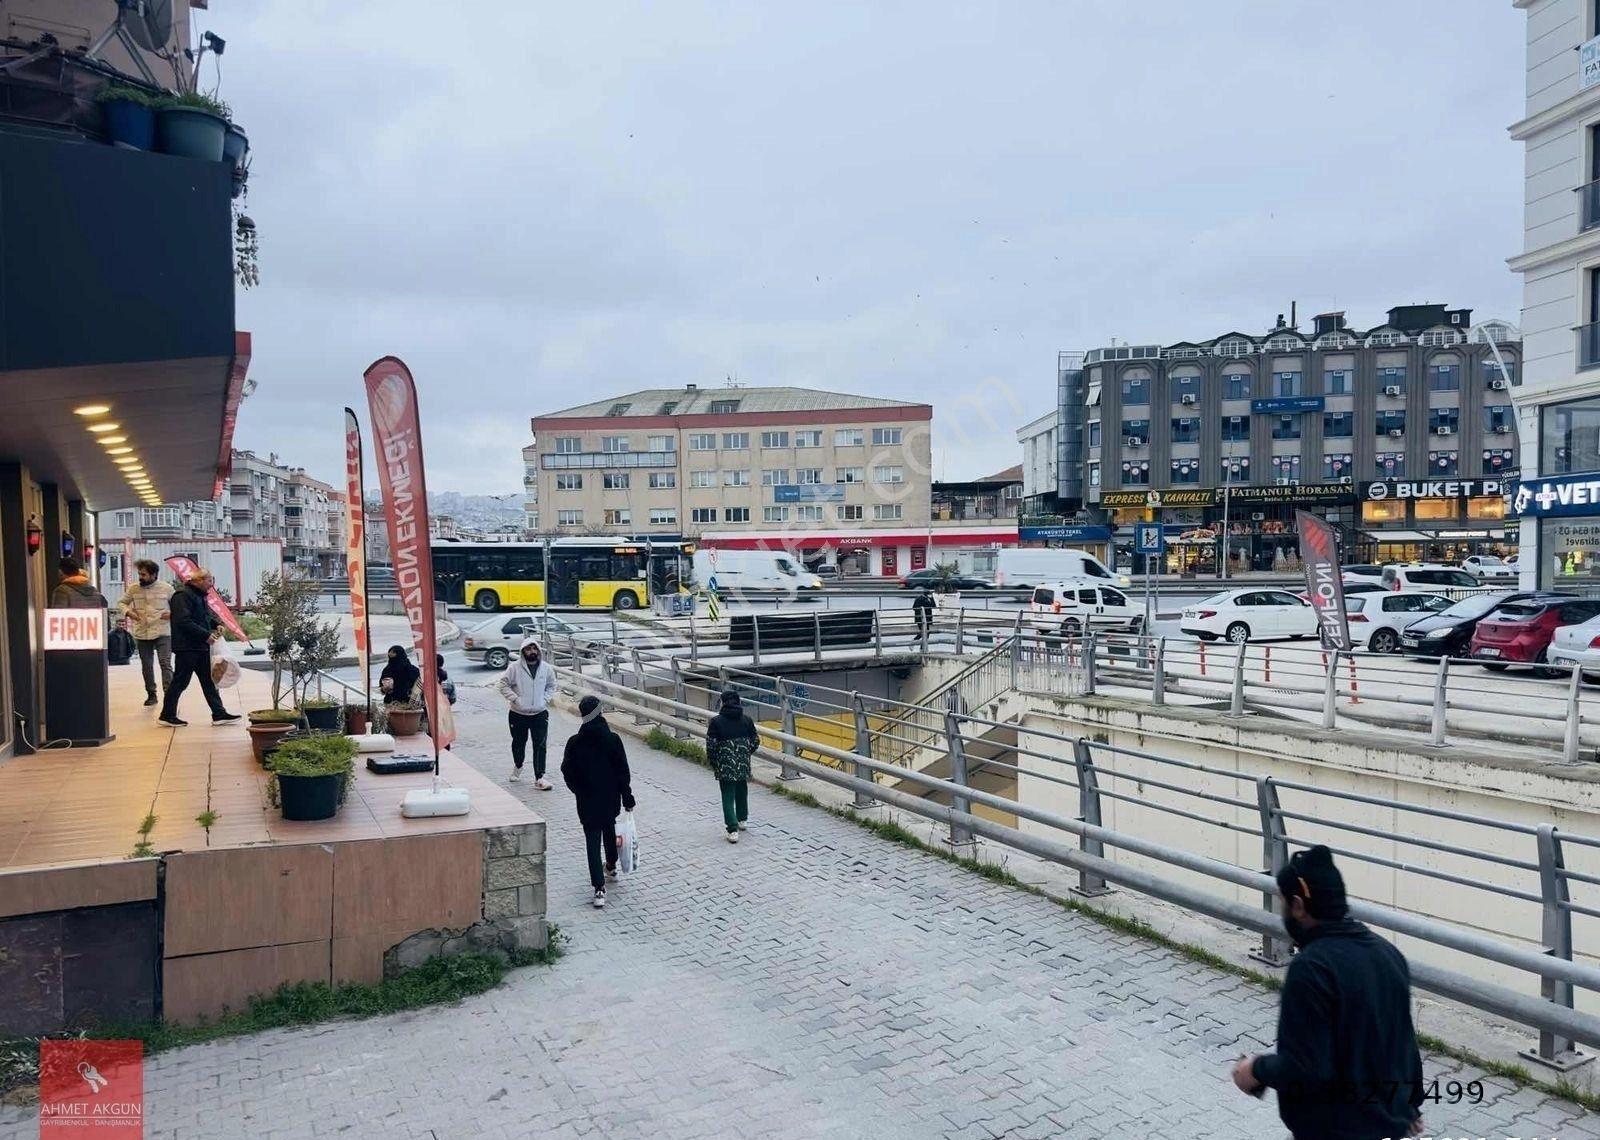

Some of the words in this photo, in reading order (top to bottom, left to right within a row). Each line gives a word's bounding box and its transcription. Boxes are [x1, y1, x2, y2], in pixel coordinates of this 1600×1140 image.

[1231, 487, 1293, 498] FATMANUR
[1296, 485, 1354, 496] HORASAN
[1397, 482, 1475, 498] BUKET
[1556, 481, 1600, 505] VET
[1103, 494, 1146, 505] EXPRESS
[1163, 492, 1212, 503] KAHVALTI
[49, 616, 98, 641] FIRIN
